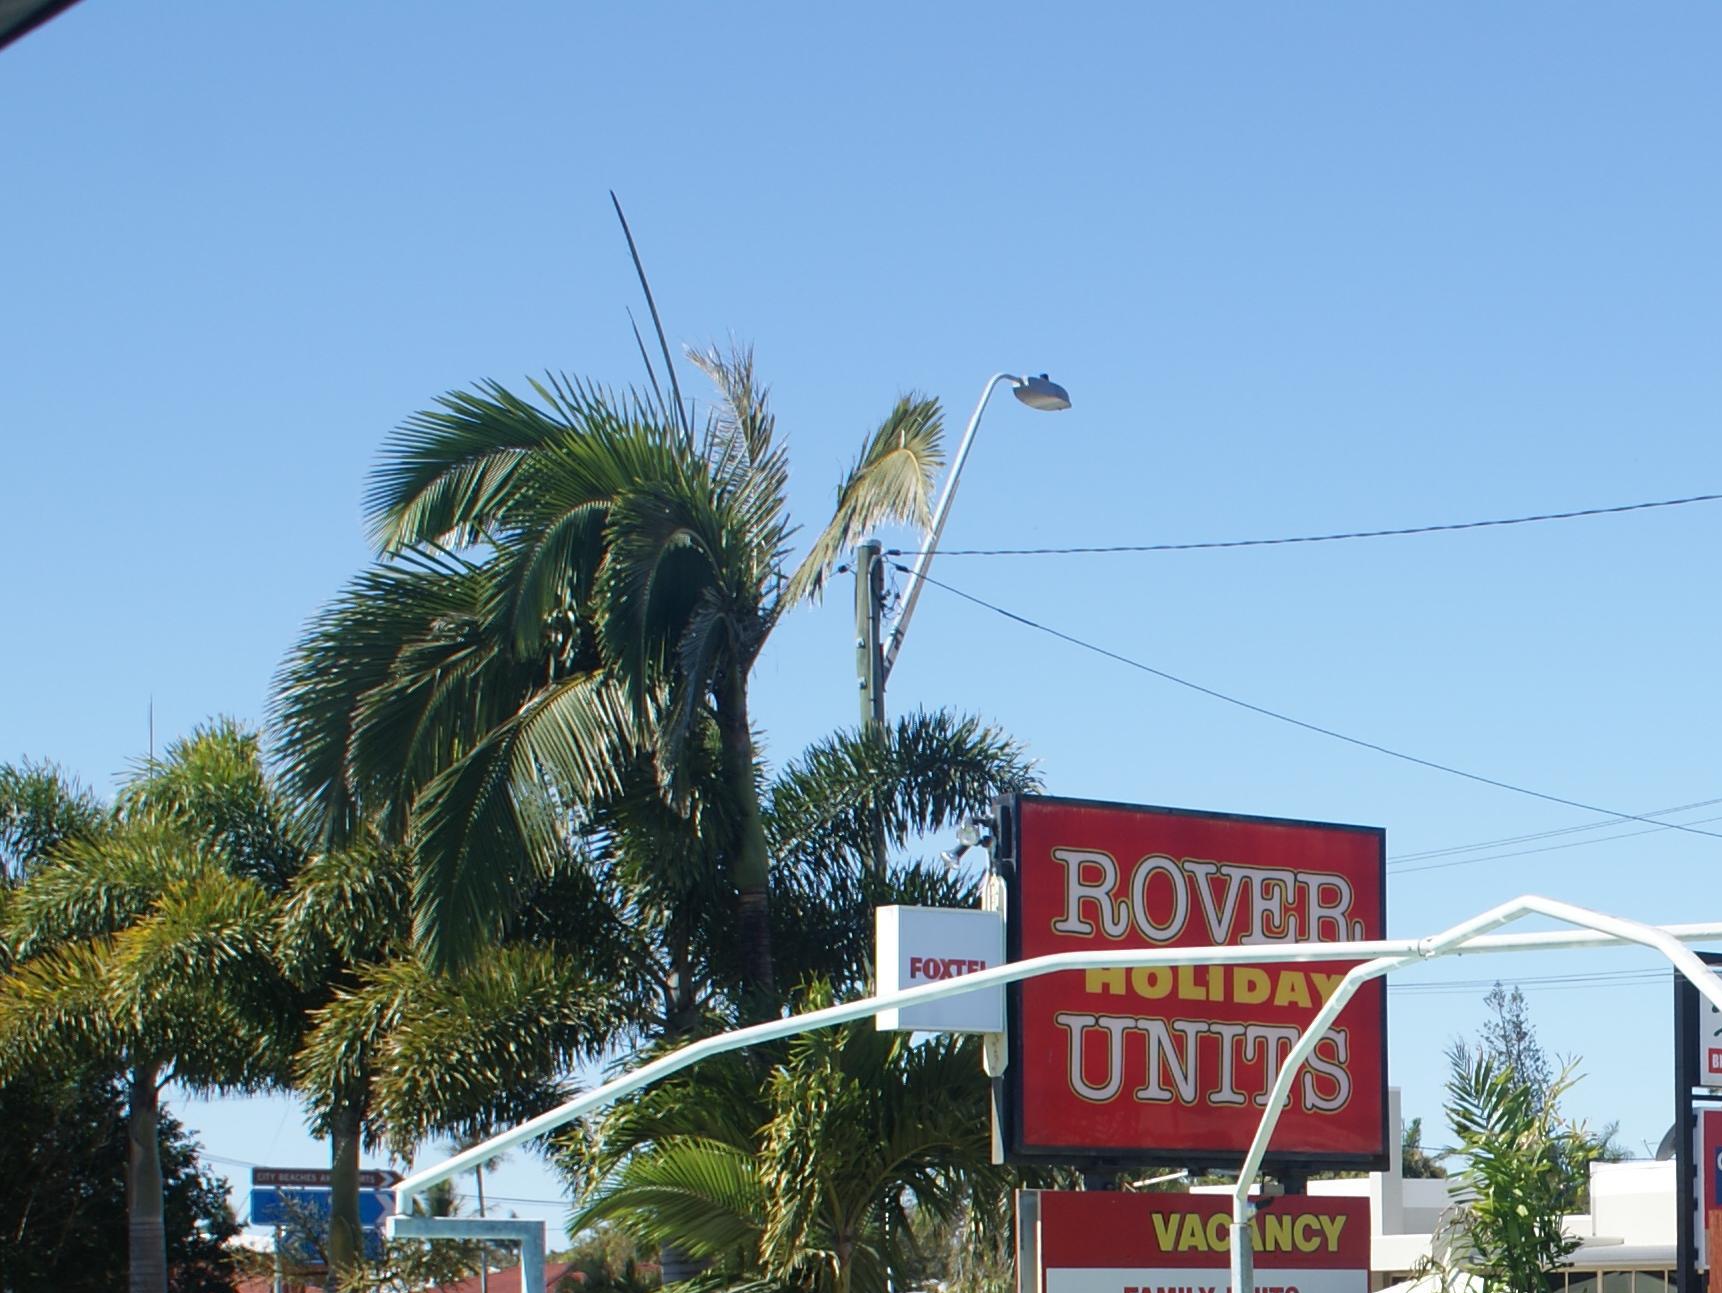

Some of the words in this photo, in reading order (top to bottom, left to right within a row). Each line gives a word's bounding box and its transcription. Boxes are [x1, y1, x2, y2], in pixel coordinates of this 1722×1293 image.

[1052, 847, 1364, 944] ROVER
[1086, 965, 1346, 1009] HOLIDAY
[1055, 1013, 1352, 1115] UNITS
